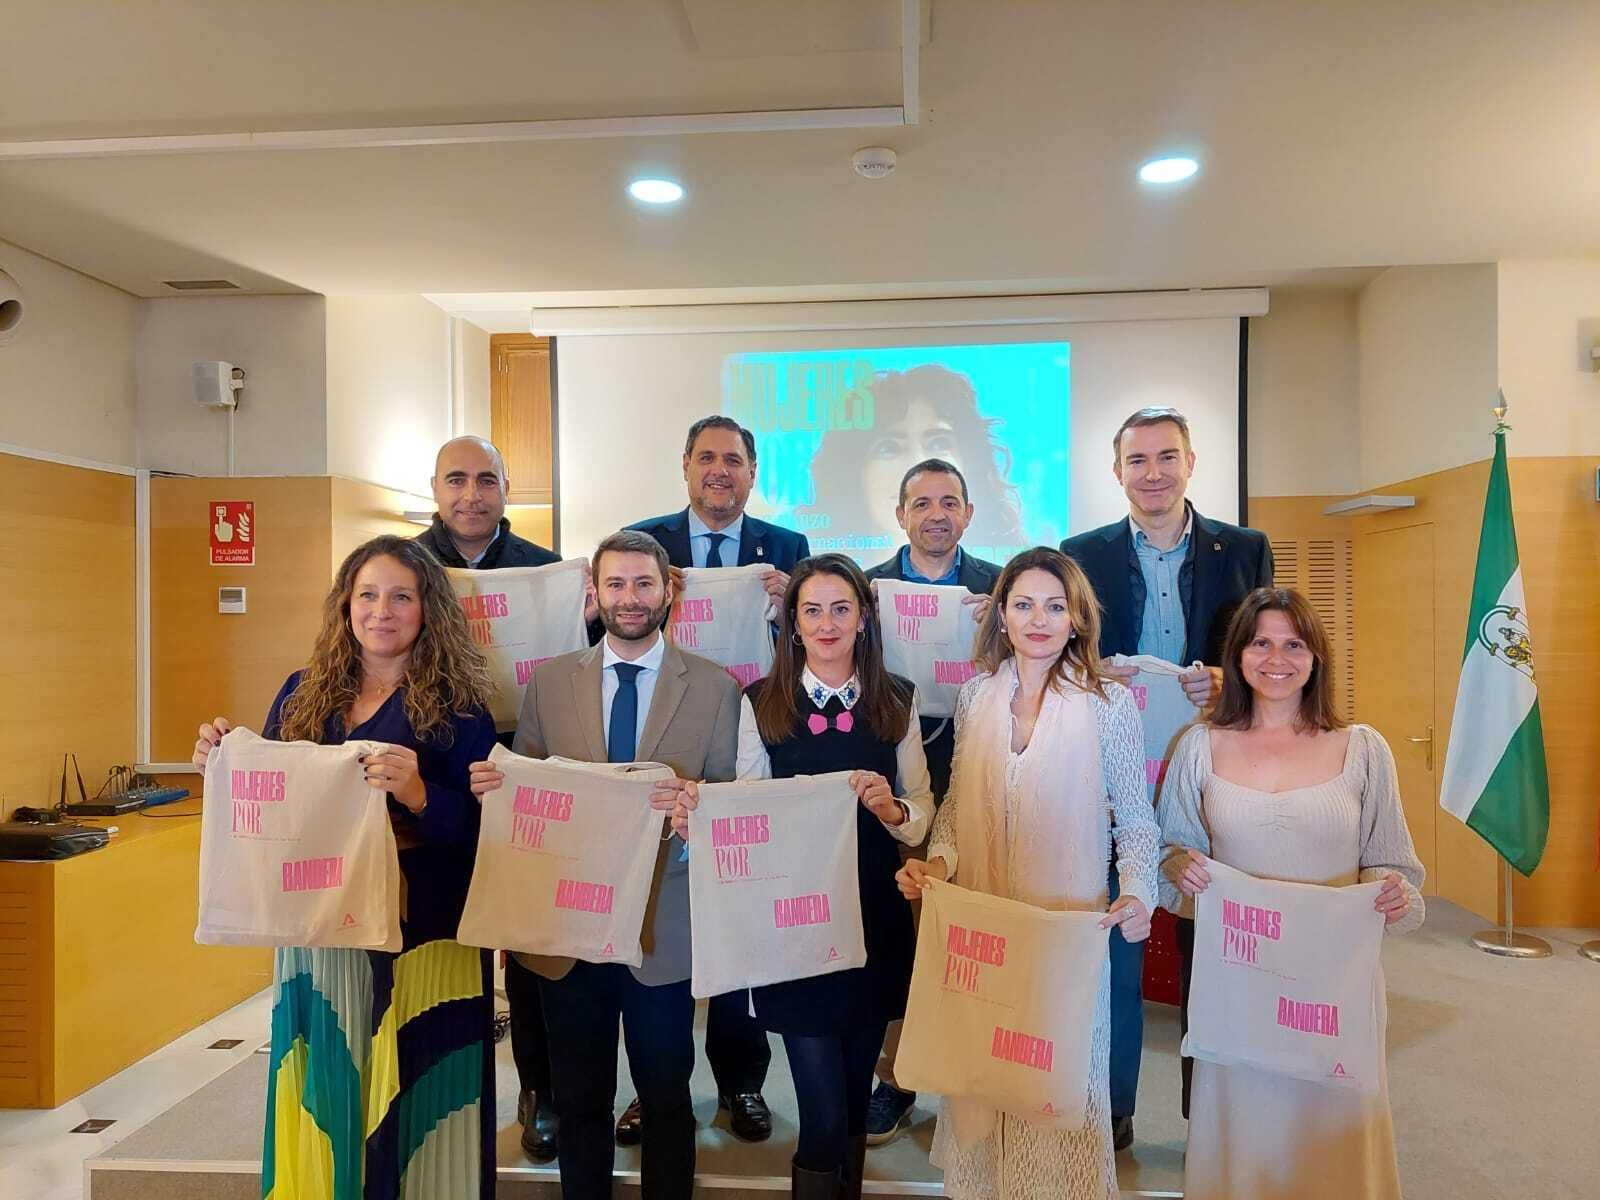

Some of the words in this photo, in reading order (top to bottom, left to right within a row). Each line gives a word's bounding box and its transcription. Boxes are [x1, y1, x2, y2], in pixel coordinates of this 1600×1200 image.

[730, 359, 875, 432] MUJERES
[894, 594, 938, 617] MUJERES
[467, 619, 492, 645] OR
[231, 768, 286, 802] MUJERES
[232, 802, 263, 834] POR
[513, 785, 575, 822] MUJERES
[511, 815, 546, 849] POR
[711, 814, 770, 848] MUJERES
[282, 856, 344, 892] BANDERA
[714, 846, 752, 879] POR
[554, 879, 615, 914] BANDERA
[773, 893, 832, 929] BANDERA
[1222, 899, 1282, 941] MUJERES
[946, 924, 1007, 968] MUJERES
[1222, 928, 1260, 963] POR
[944, 956, 979, 993] POR
[1277, 996, 1340, 1037] BANDERA
[991, 1026, 1054, 1073] BANDERA
